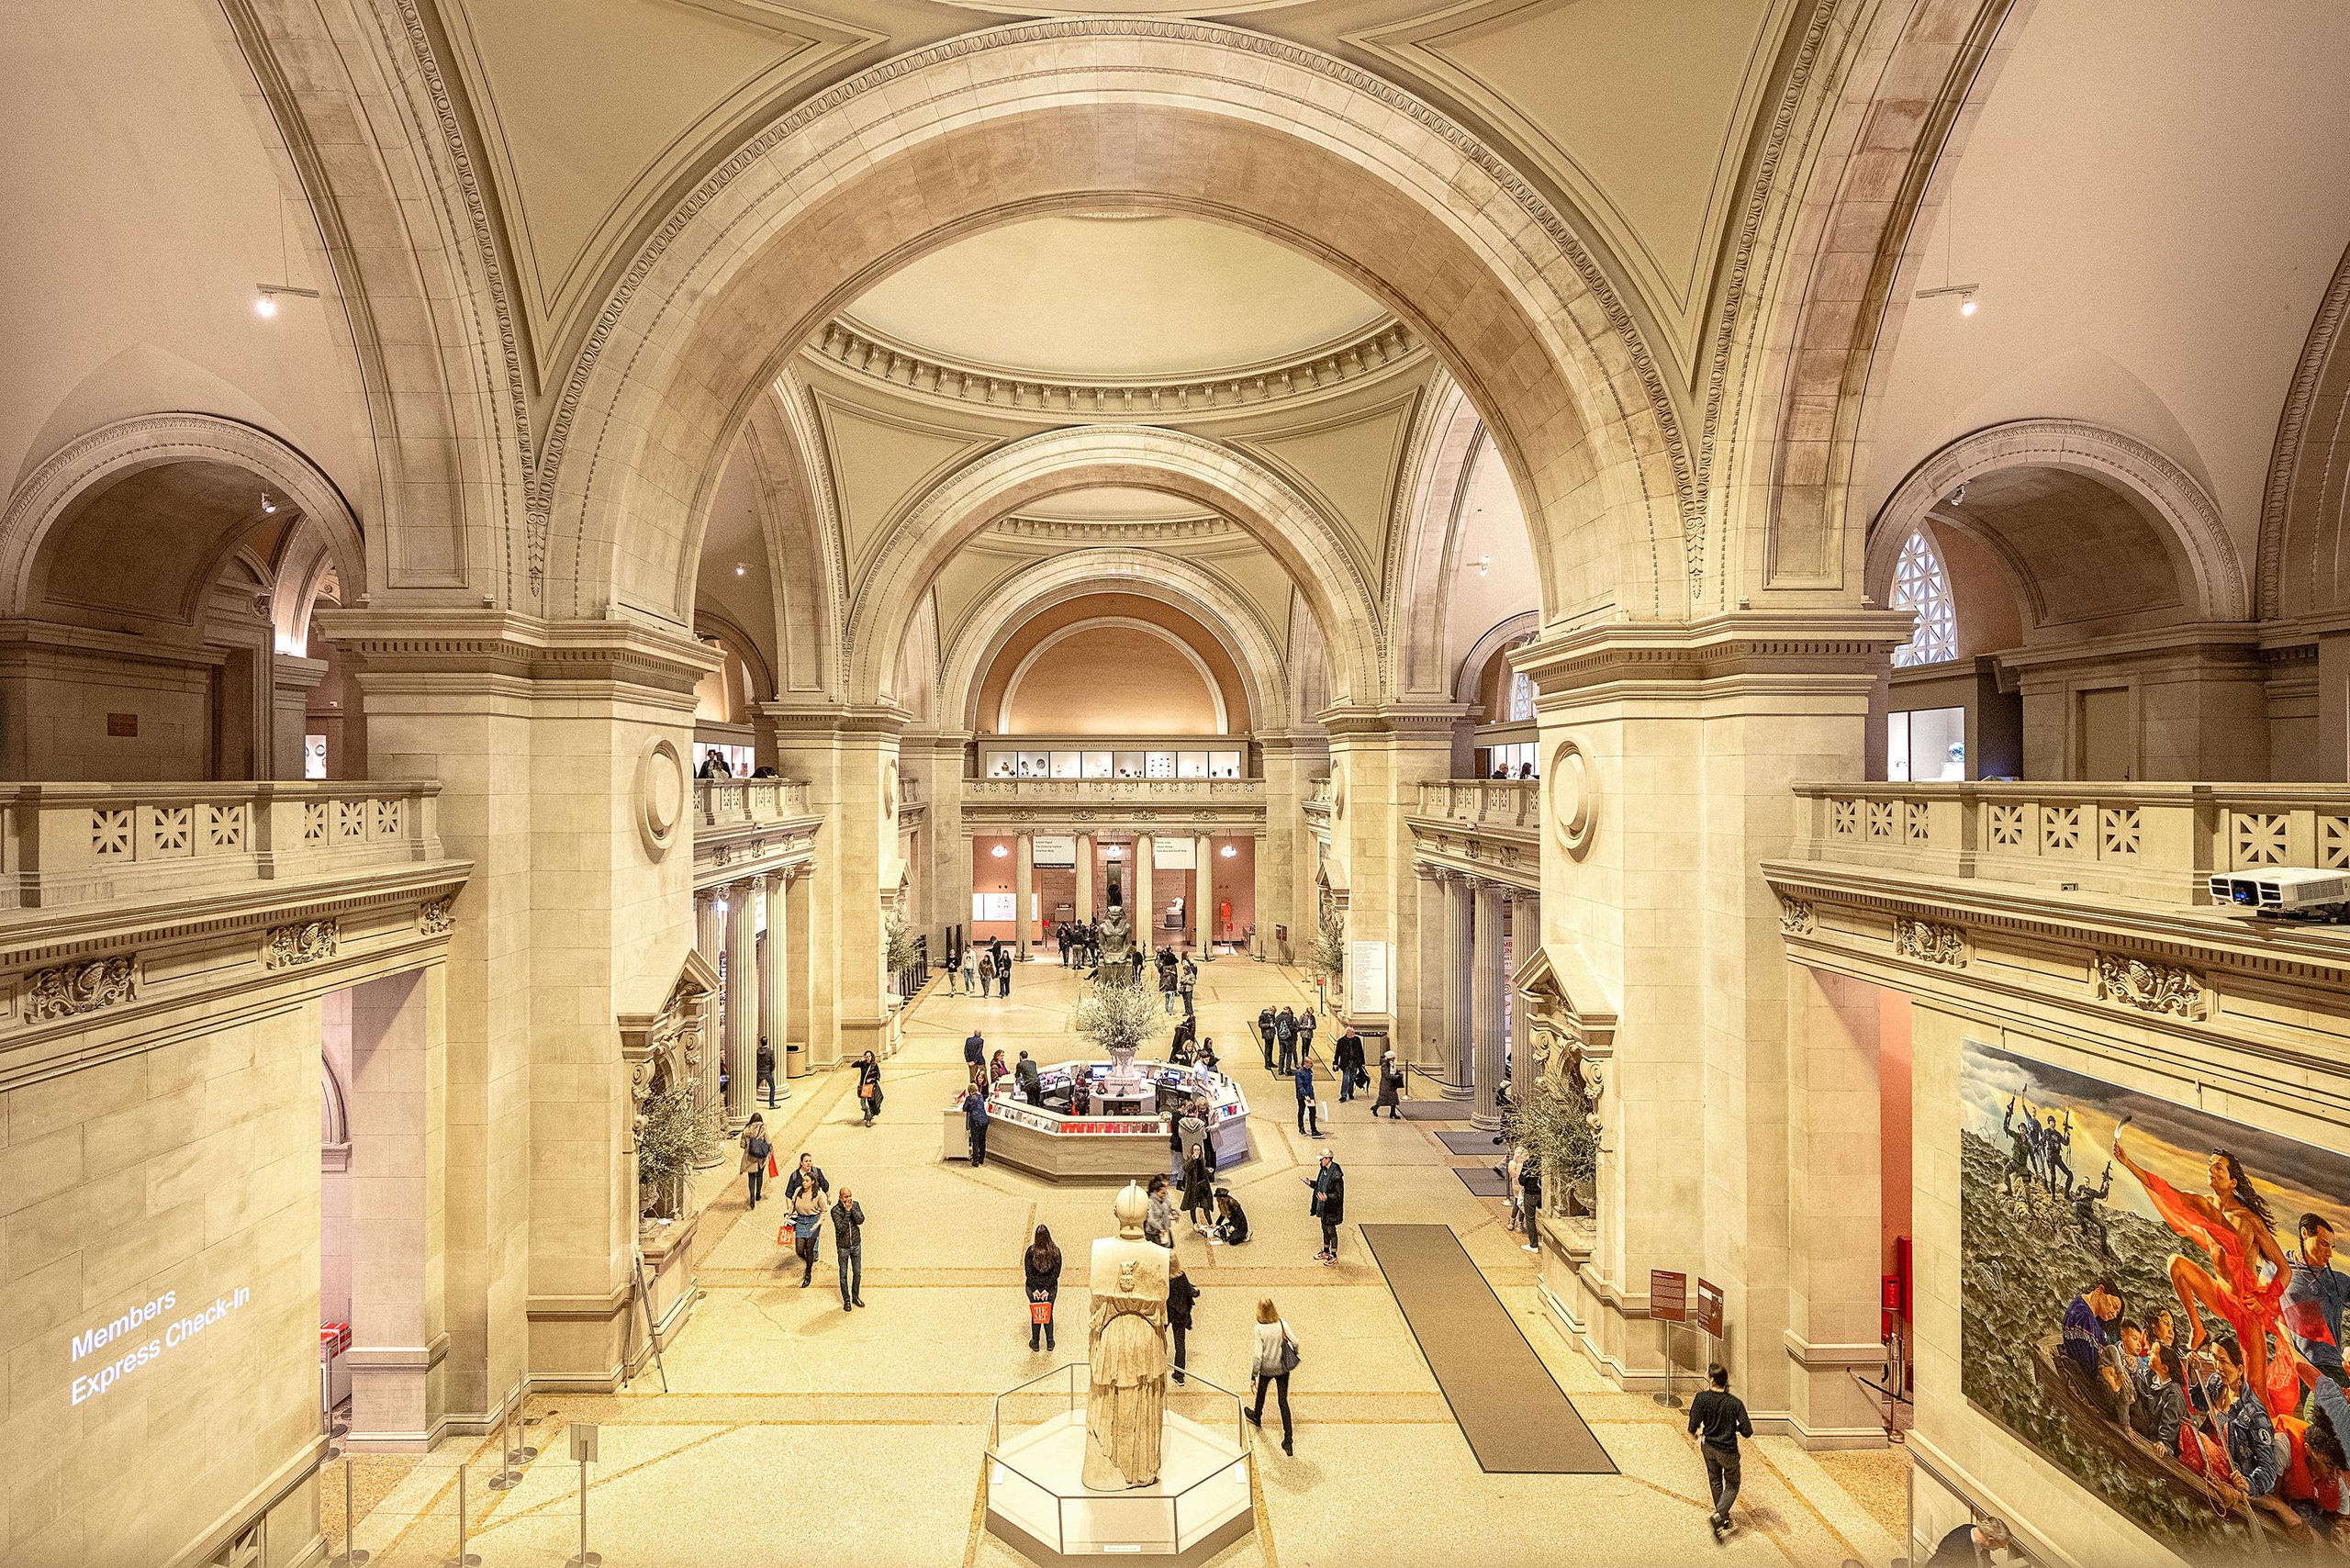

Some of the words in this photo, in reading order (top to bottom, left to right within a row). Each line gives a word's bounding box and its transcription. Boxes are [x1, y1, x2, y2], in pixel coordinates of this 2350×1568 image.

[72, 1290, 176, 1361] Members
[72, 1338, 161, 1406] Express
[165, 1286, 250, 1348] Check-In
